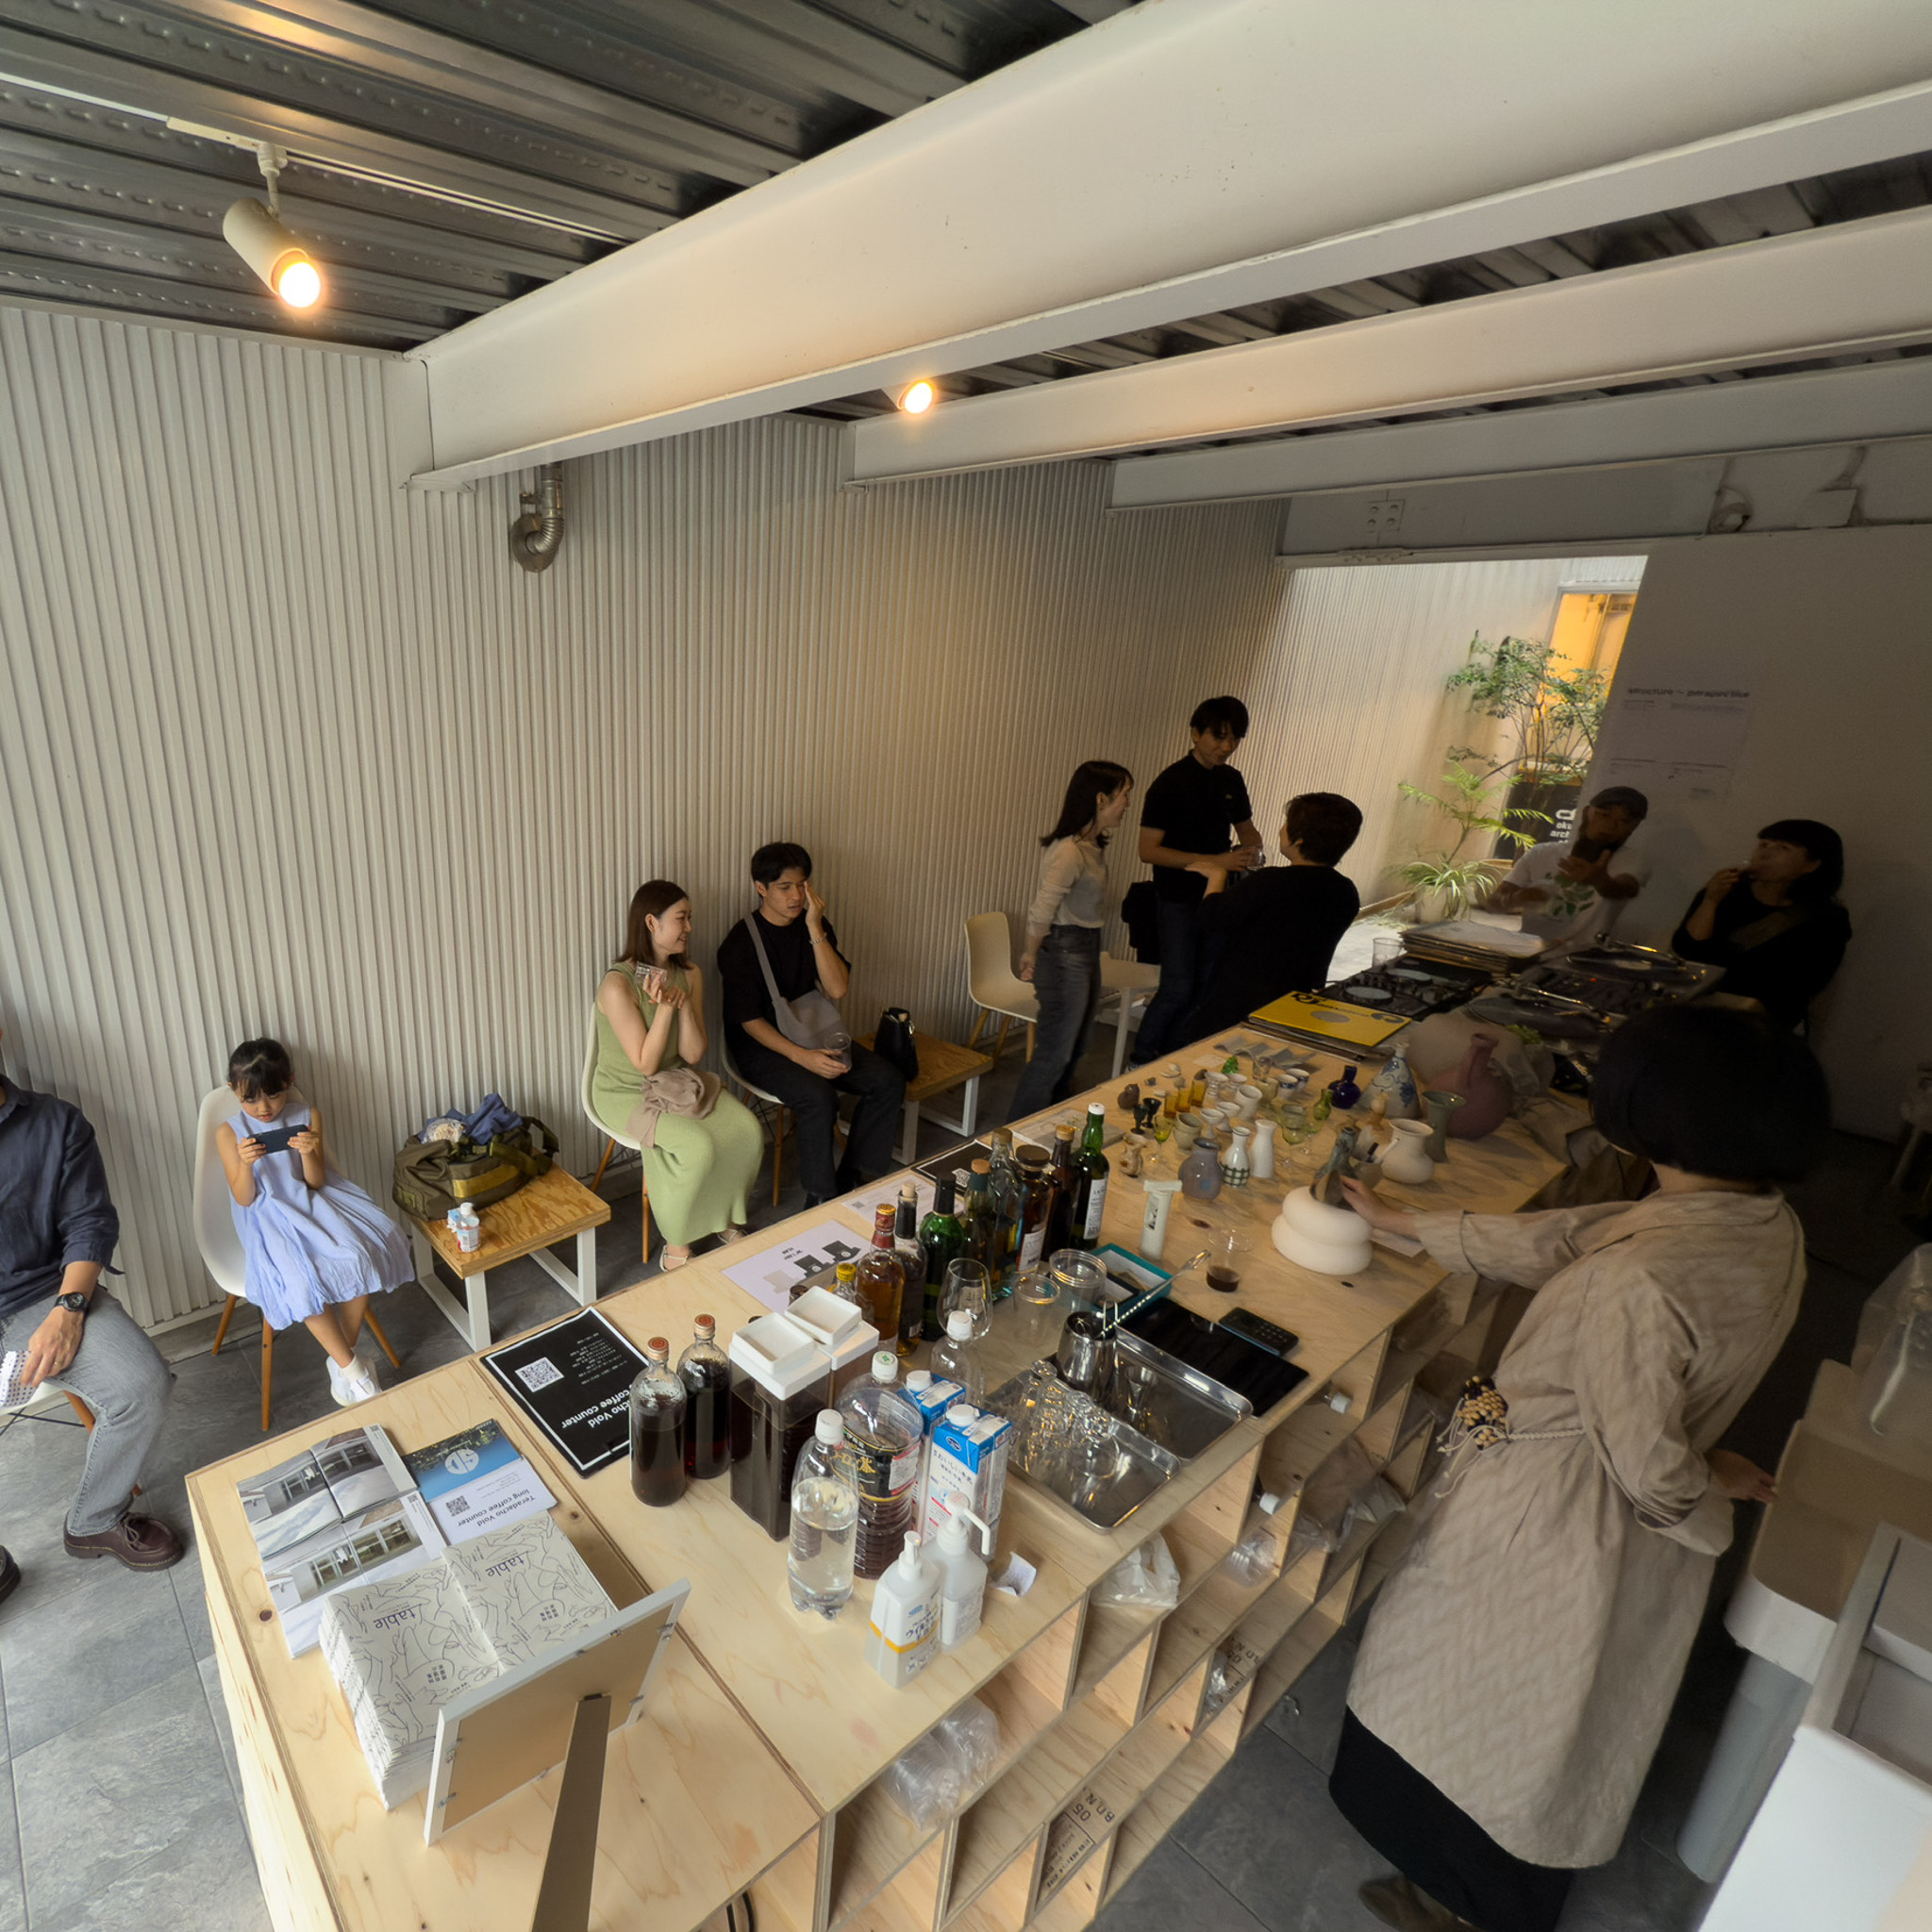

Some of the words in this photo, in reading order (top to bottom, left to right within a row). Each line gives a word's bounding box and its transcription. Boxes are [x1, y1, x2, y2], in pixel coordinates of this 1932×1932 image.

[599, 1389, 630, 1408] coffee
[561, 1406, 599, 1429] counter
[489, 1497, 512, 1511] coffee
[512, 1489, 529, 1499] long
[495, 1494, 535, 1517] Teradacho
[458, 1509, 487, 1526] counter
[485, 1555, 525, 1577] table
[373, 1608, 416, 1630] table
